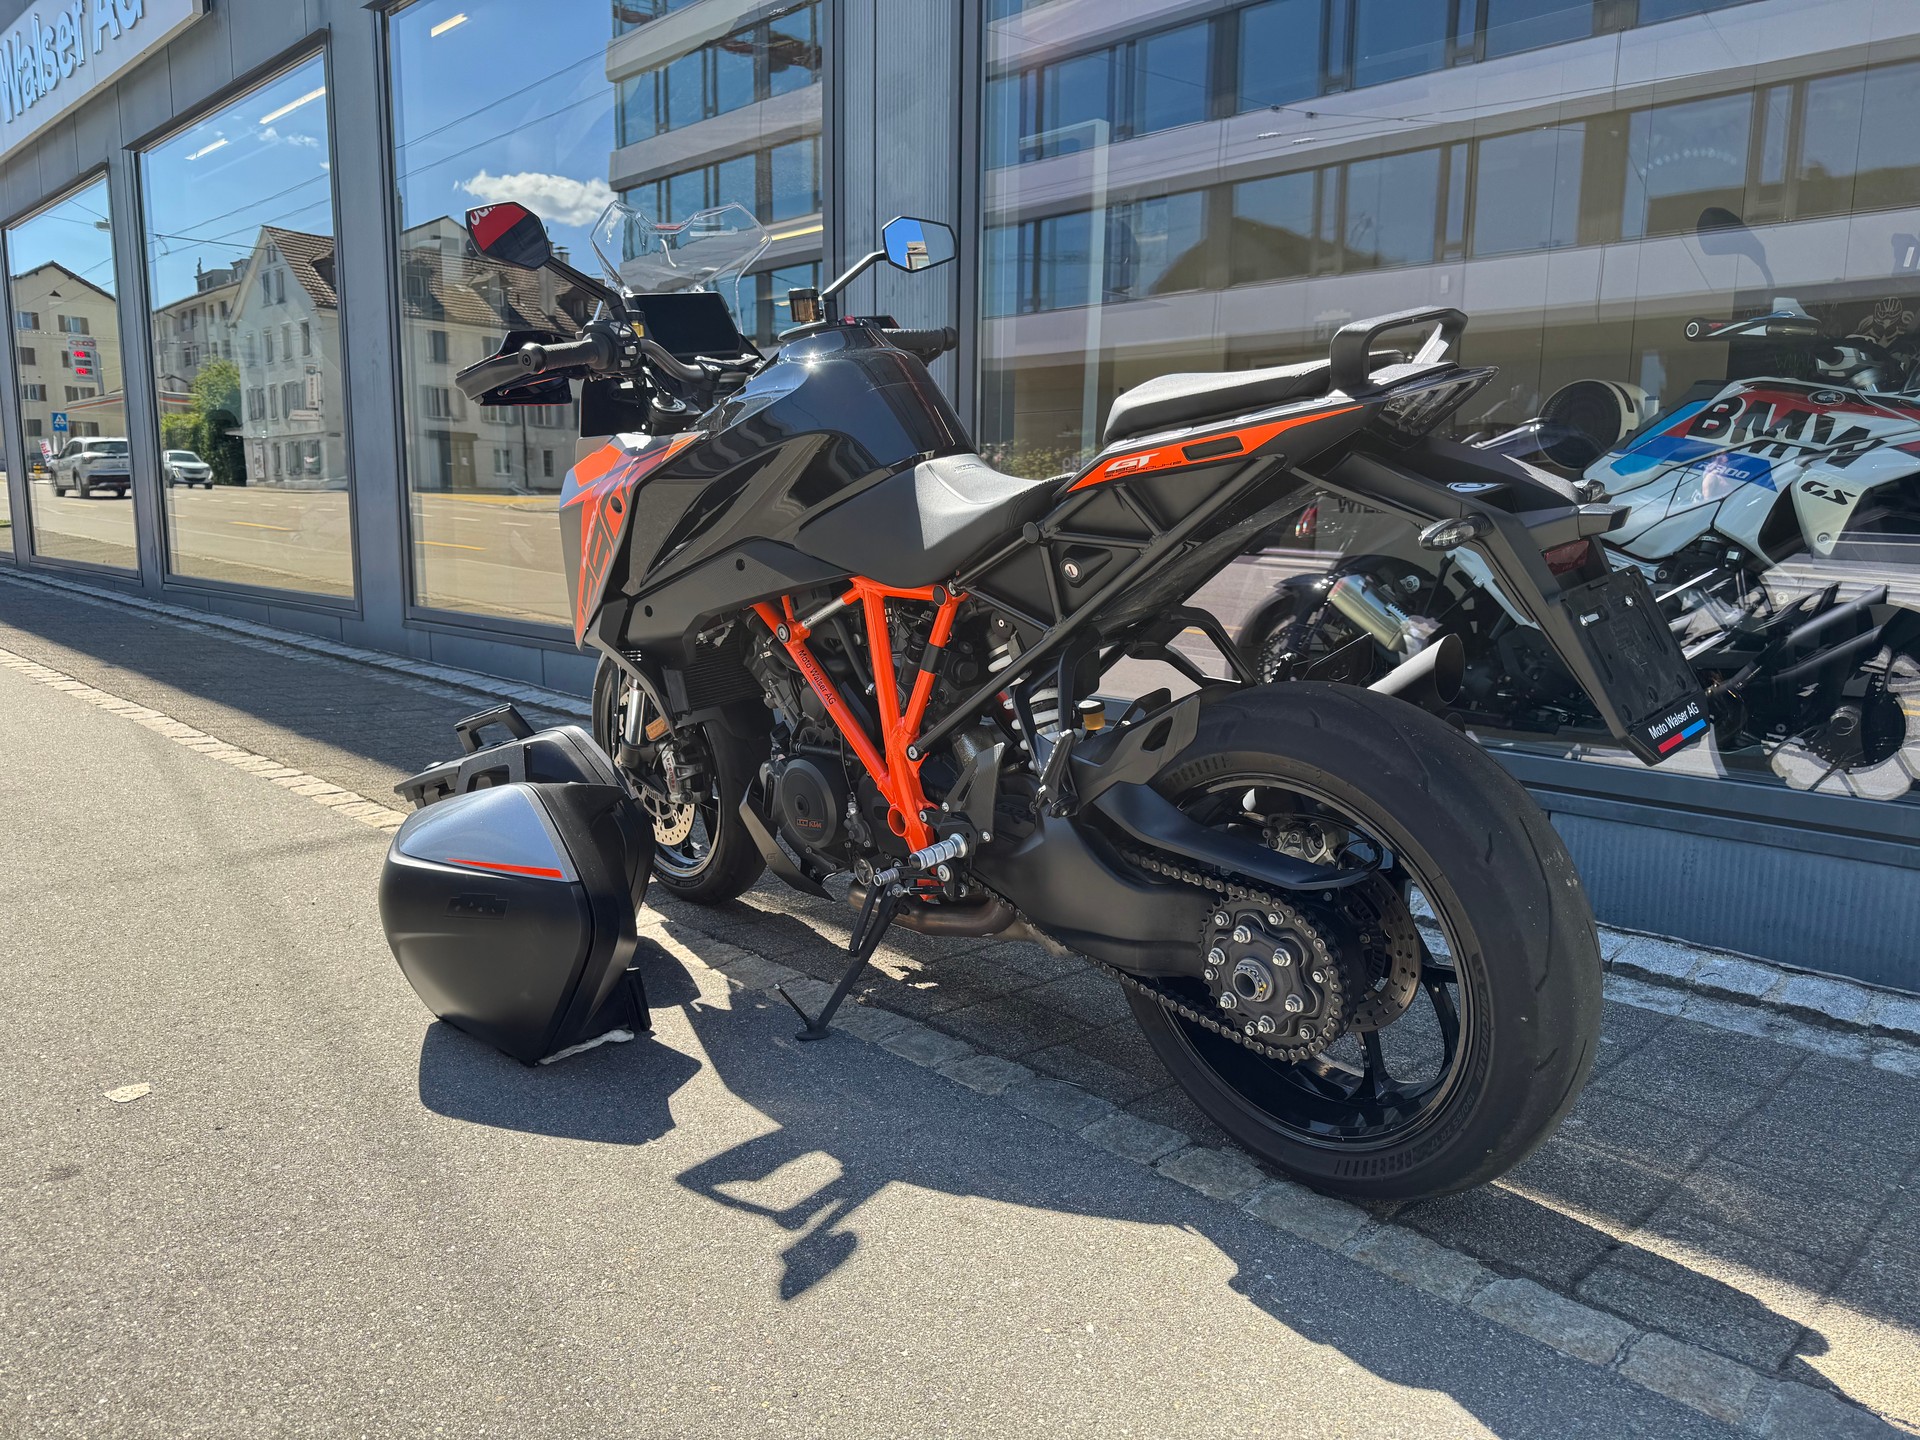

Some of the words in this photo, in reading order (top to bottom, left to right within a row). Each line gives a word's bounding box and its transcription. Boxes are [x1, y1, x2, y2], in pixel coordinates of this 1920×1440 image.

[0, 0, 86, 123] Walser
[1685, 396, 1888, 469] BMW
[1105, 452, 1161, 472] GT
[1801, 480, 1857, 505] GS
[798, 650, 811, 668] Moto
[810, 668, 828, 692] Walser
[825, 693, 836, 705] AG
[1648, 723, 1668, 740] Moto
[1664, 710, 1689, 729] Walser
[1686, 701, 1700, 718] AG
